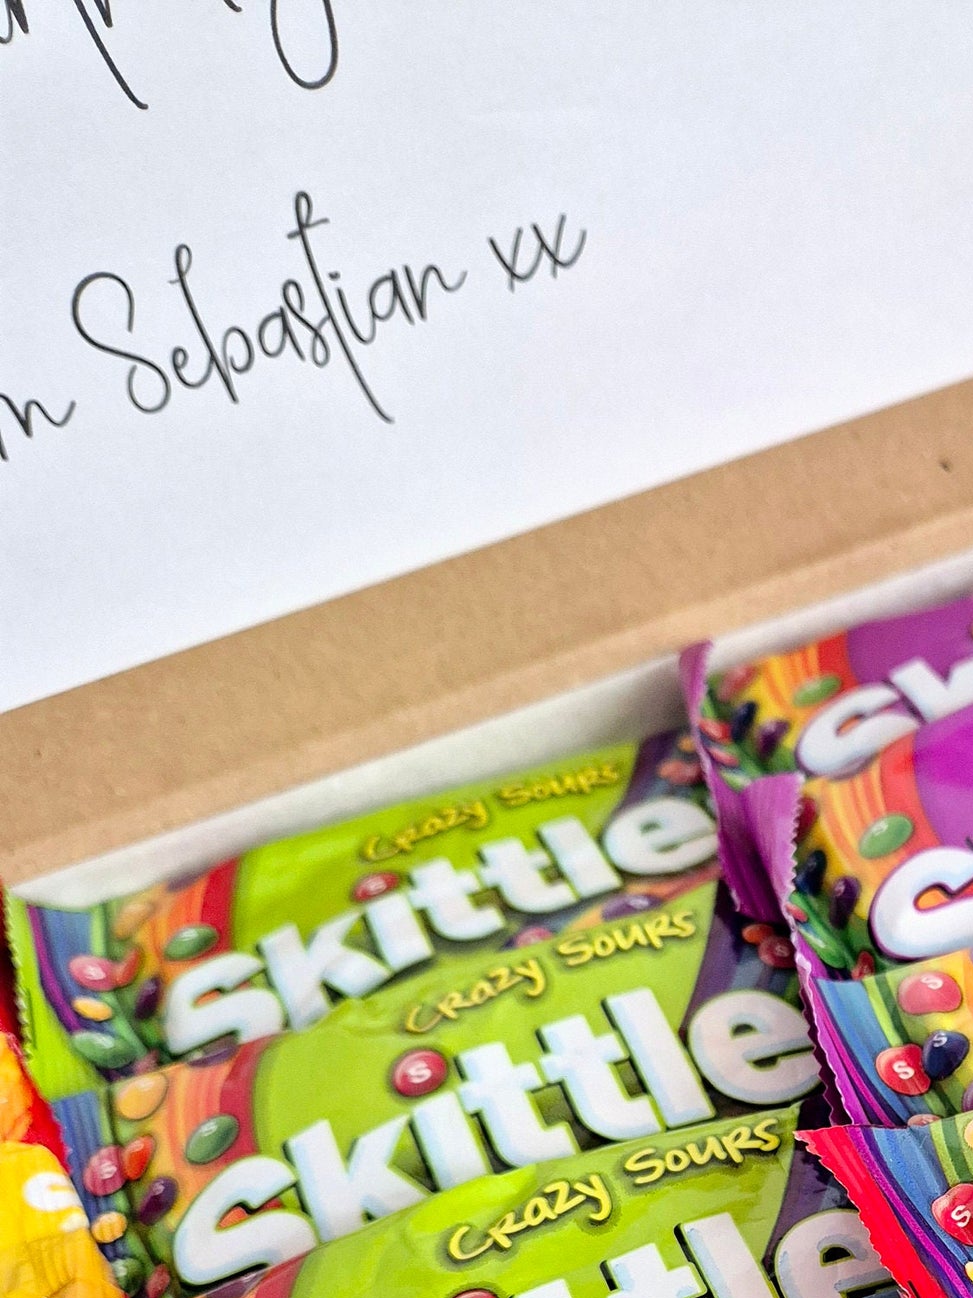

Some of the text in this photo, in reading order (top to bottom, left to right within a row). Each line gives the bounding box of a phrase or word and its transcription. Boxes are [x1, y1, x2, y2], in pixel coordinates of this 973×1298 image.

[71, 190, 587, 424] Sebastian xx
[363, 760, 619, 862] Crazy Sours
[406, 910, 697, 1034] Crazy Sours
[447, 1116, 781, 1262] Crazy Sours
